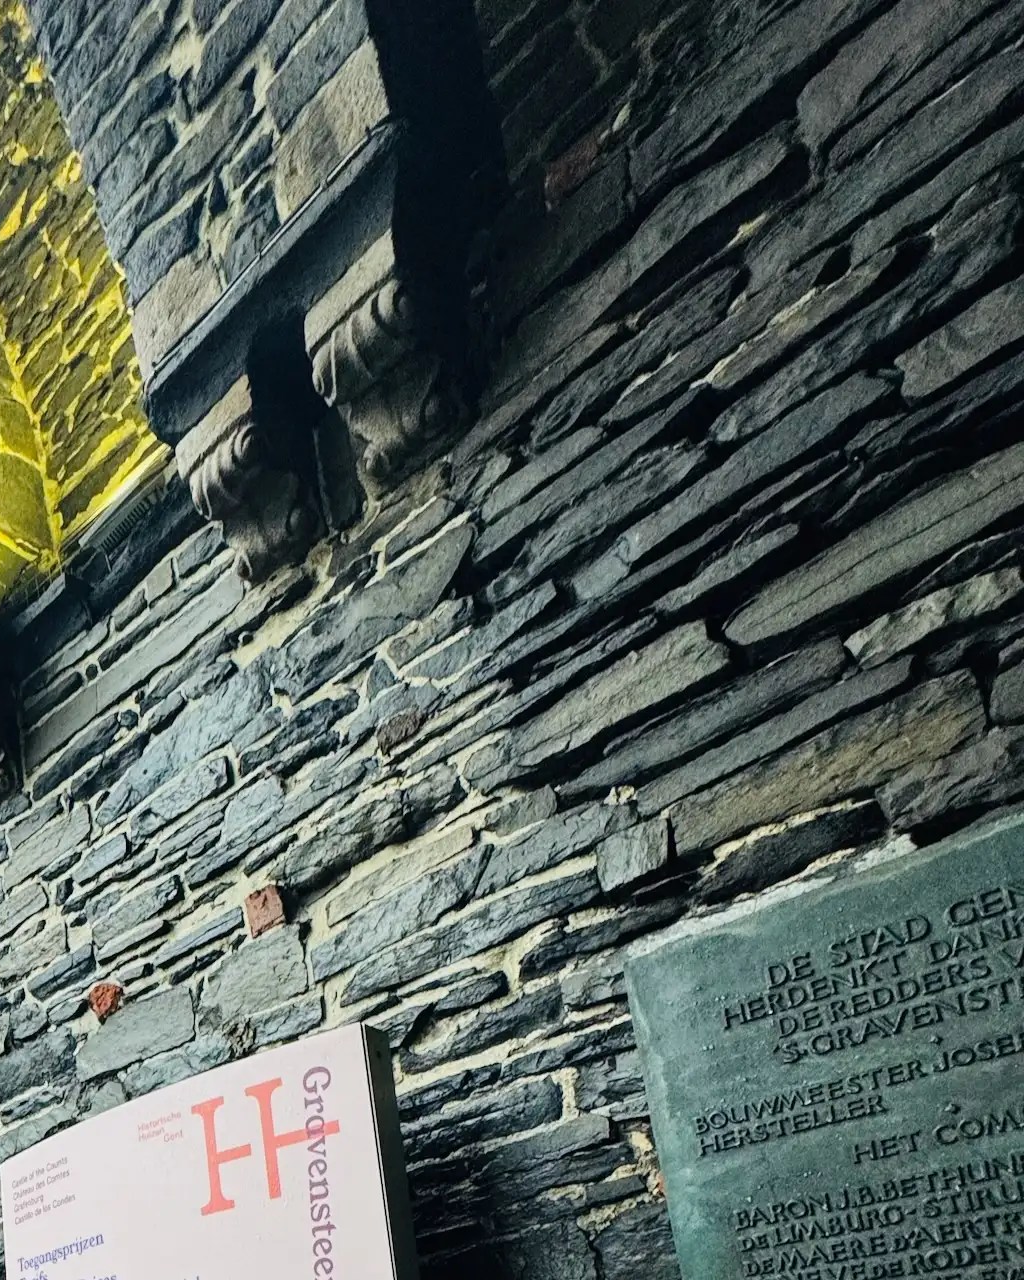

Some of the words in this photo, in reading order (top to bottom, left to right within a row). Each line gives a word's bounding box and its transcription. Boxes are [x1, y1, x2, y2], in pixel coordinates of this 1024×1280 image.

[768, 953, 816, 990] DE
[829, 914, 932, 968] STAD
[724, 951, 907, 1031] HERDENKT
[777, 1004, 824, 1040] DE
[826, 955, 992, 1026] REDDERS
[694, 1059, 928, 1136] BOUWMEESTER
[137, 1111, 182, 1133] Historische
[138, 1127, 165, 1142] Huizen
[163, 1129, 184, 1143] Gent
[696, 1094, 890, 1158] HERSTELLER
[852, 1129, 921, 1164] HET
[11, 1176, 28, 1189] Castle
[35, 1167, 45, 1179] the
[46, 1156, 68, 1173] Counts
[35, 1179, 46, 1190] des
[46, 1169, 70, 1185] Comtes
[34, 1207, 42, 1217] de
[43, 1203, 51, 1213] los
[52, 1193, 76, 1209] Condes
[734, 1193, 832, 1232] BARON
[17, 1232, 104, 1272] Toegangsprijzen
[738, 1233, 769, 1252] DE
[742, 1258, 774, 1278] DE
[778, 1234, 888, 1273] MAERE
